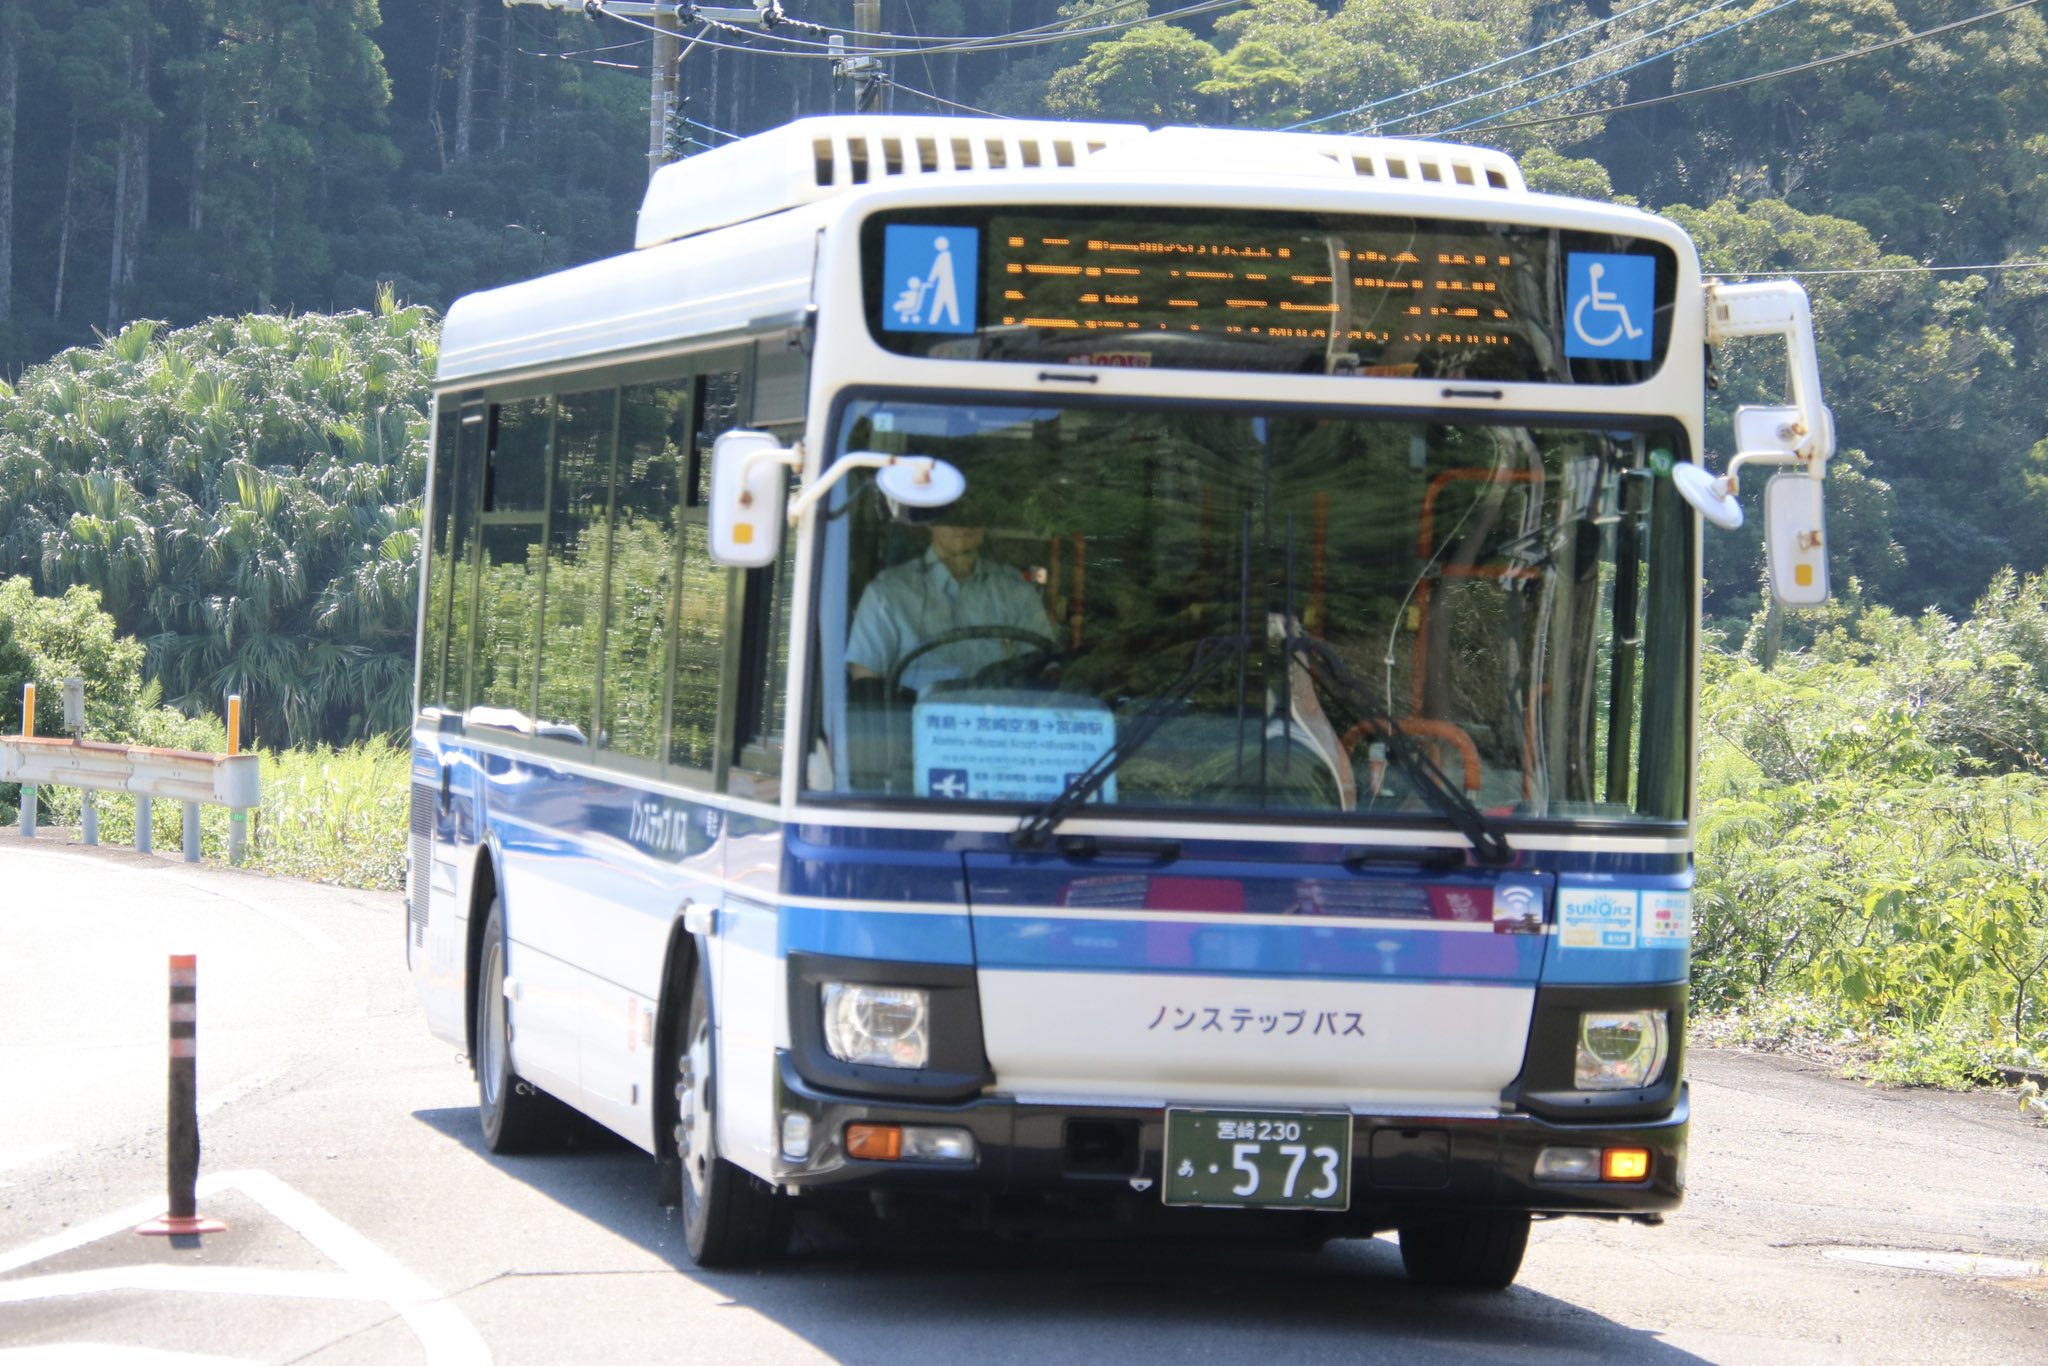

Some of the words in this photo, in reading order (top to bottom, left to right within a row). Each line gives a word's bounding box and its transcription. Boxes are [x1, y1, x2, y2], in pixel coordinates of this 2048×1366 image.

[1148, 1006, 1365, 1038] ノンステップバス
